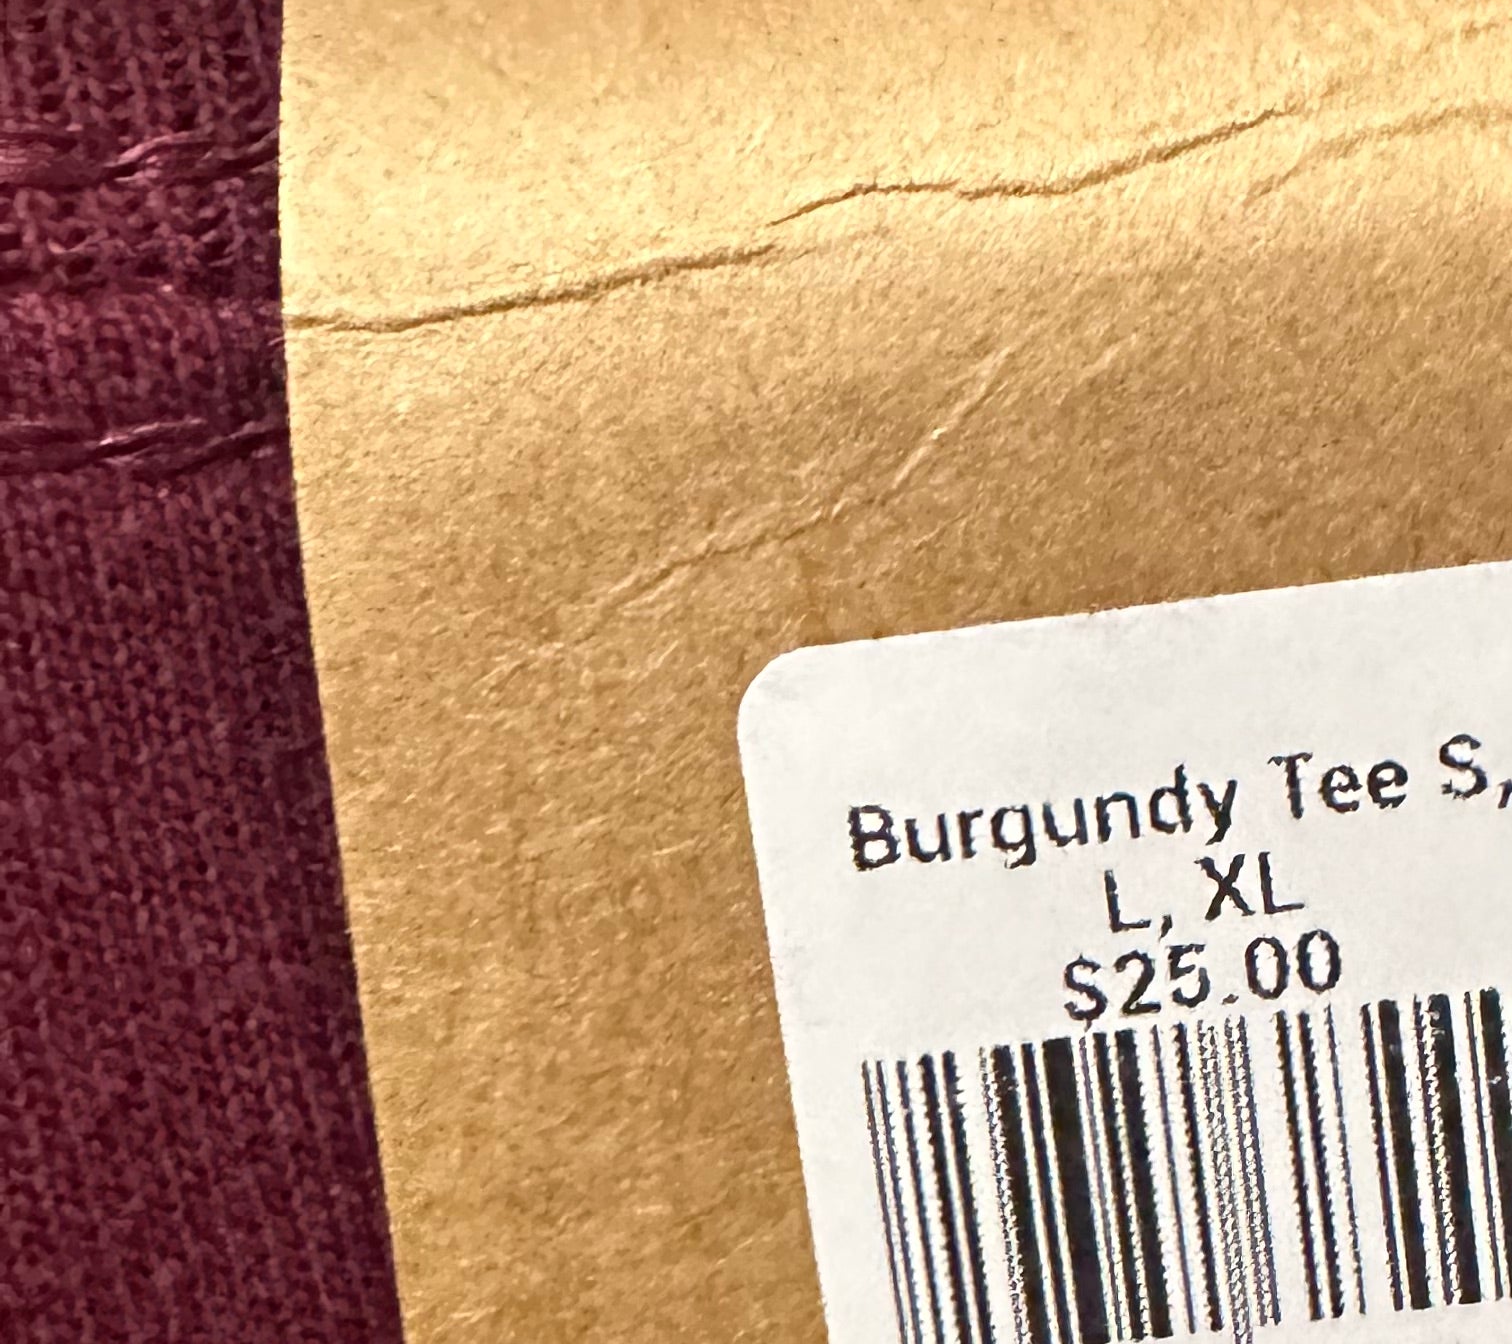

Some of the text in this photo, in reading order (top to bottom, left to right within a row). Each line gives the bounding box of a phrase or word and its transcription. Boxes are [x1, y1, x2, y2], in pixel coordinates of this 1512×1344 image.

[848, 763, 1237, 871] Burgundy
[1269, 753, 1409, 819] Tee
[1105, 851, 1306, 941] L, XL
[1062, 929, 1342, 1029] $25.00
